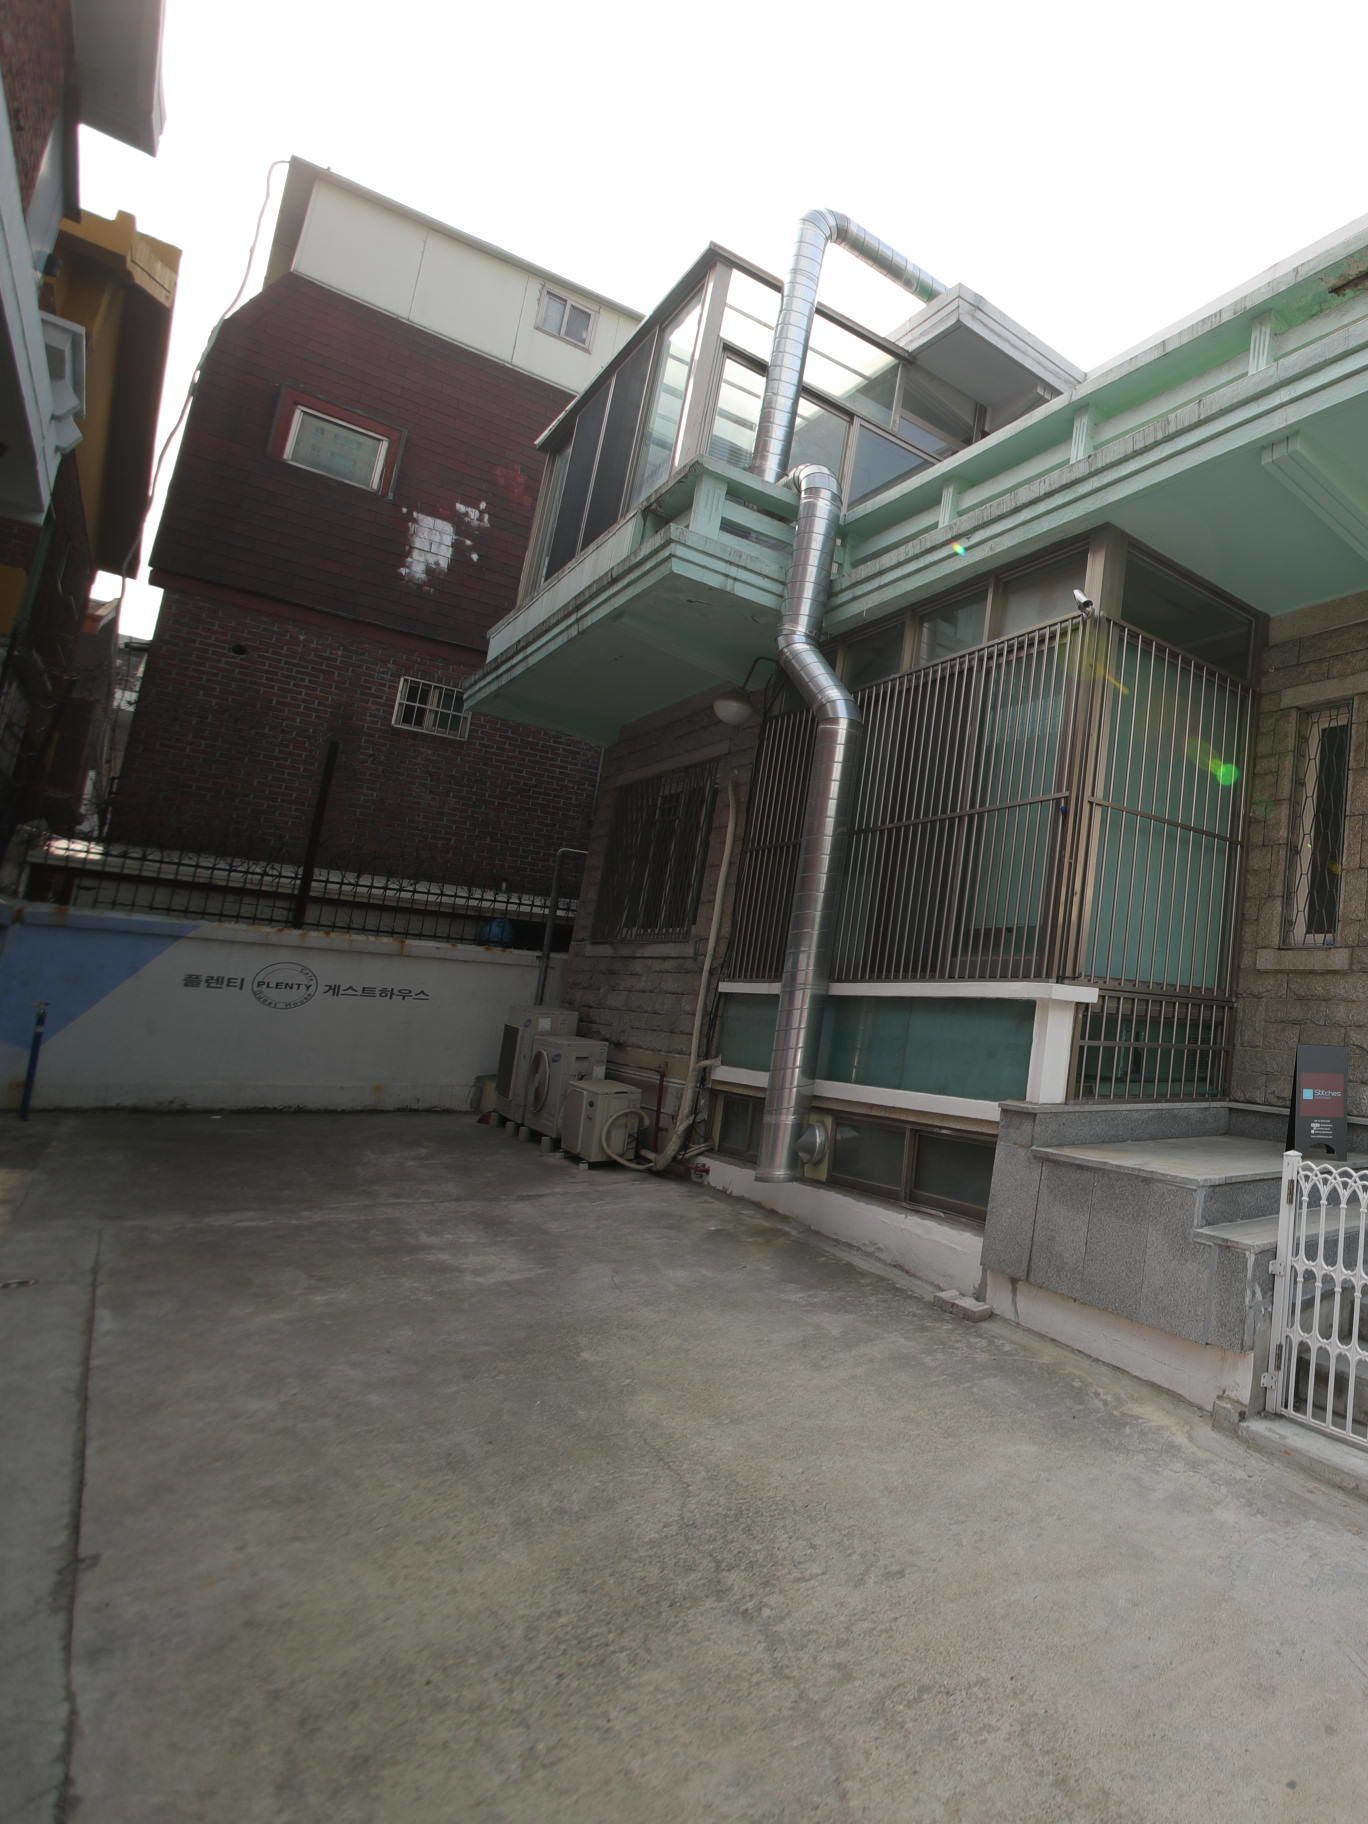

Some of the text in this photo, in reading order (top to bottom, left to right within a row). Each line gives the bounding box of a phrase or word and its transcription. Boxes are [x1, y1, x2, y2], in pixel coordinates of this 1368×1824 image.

[183, 973, 246, 991] 플렌티
[256, 980, 313, 992] PLENTY
[322, 983, 431, 1001] 게스트하우스
